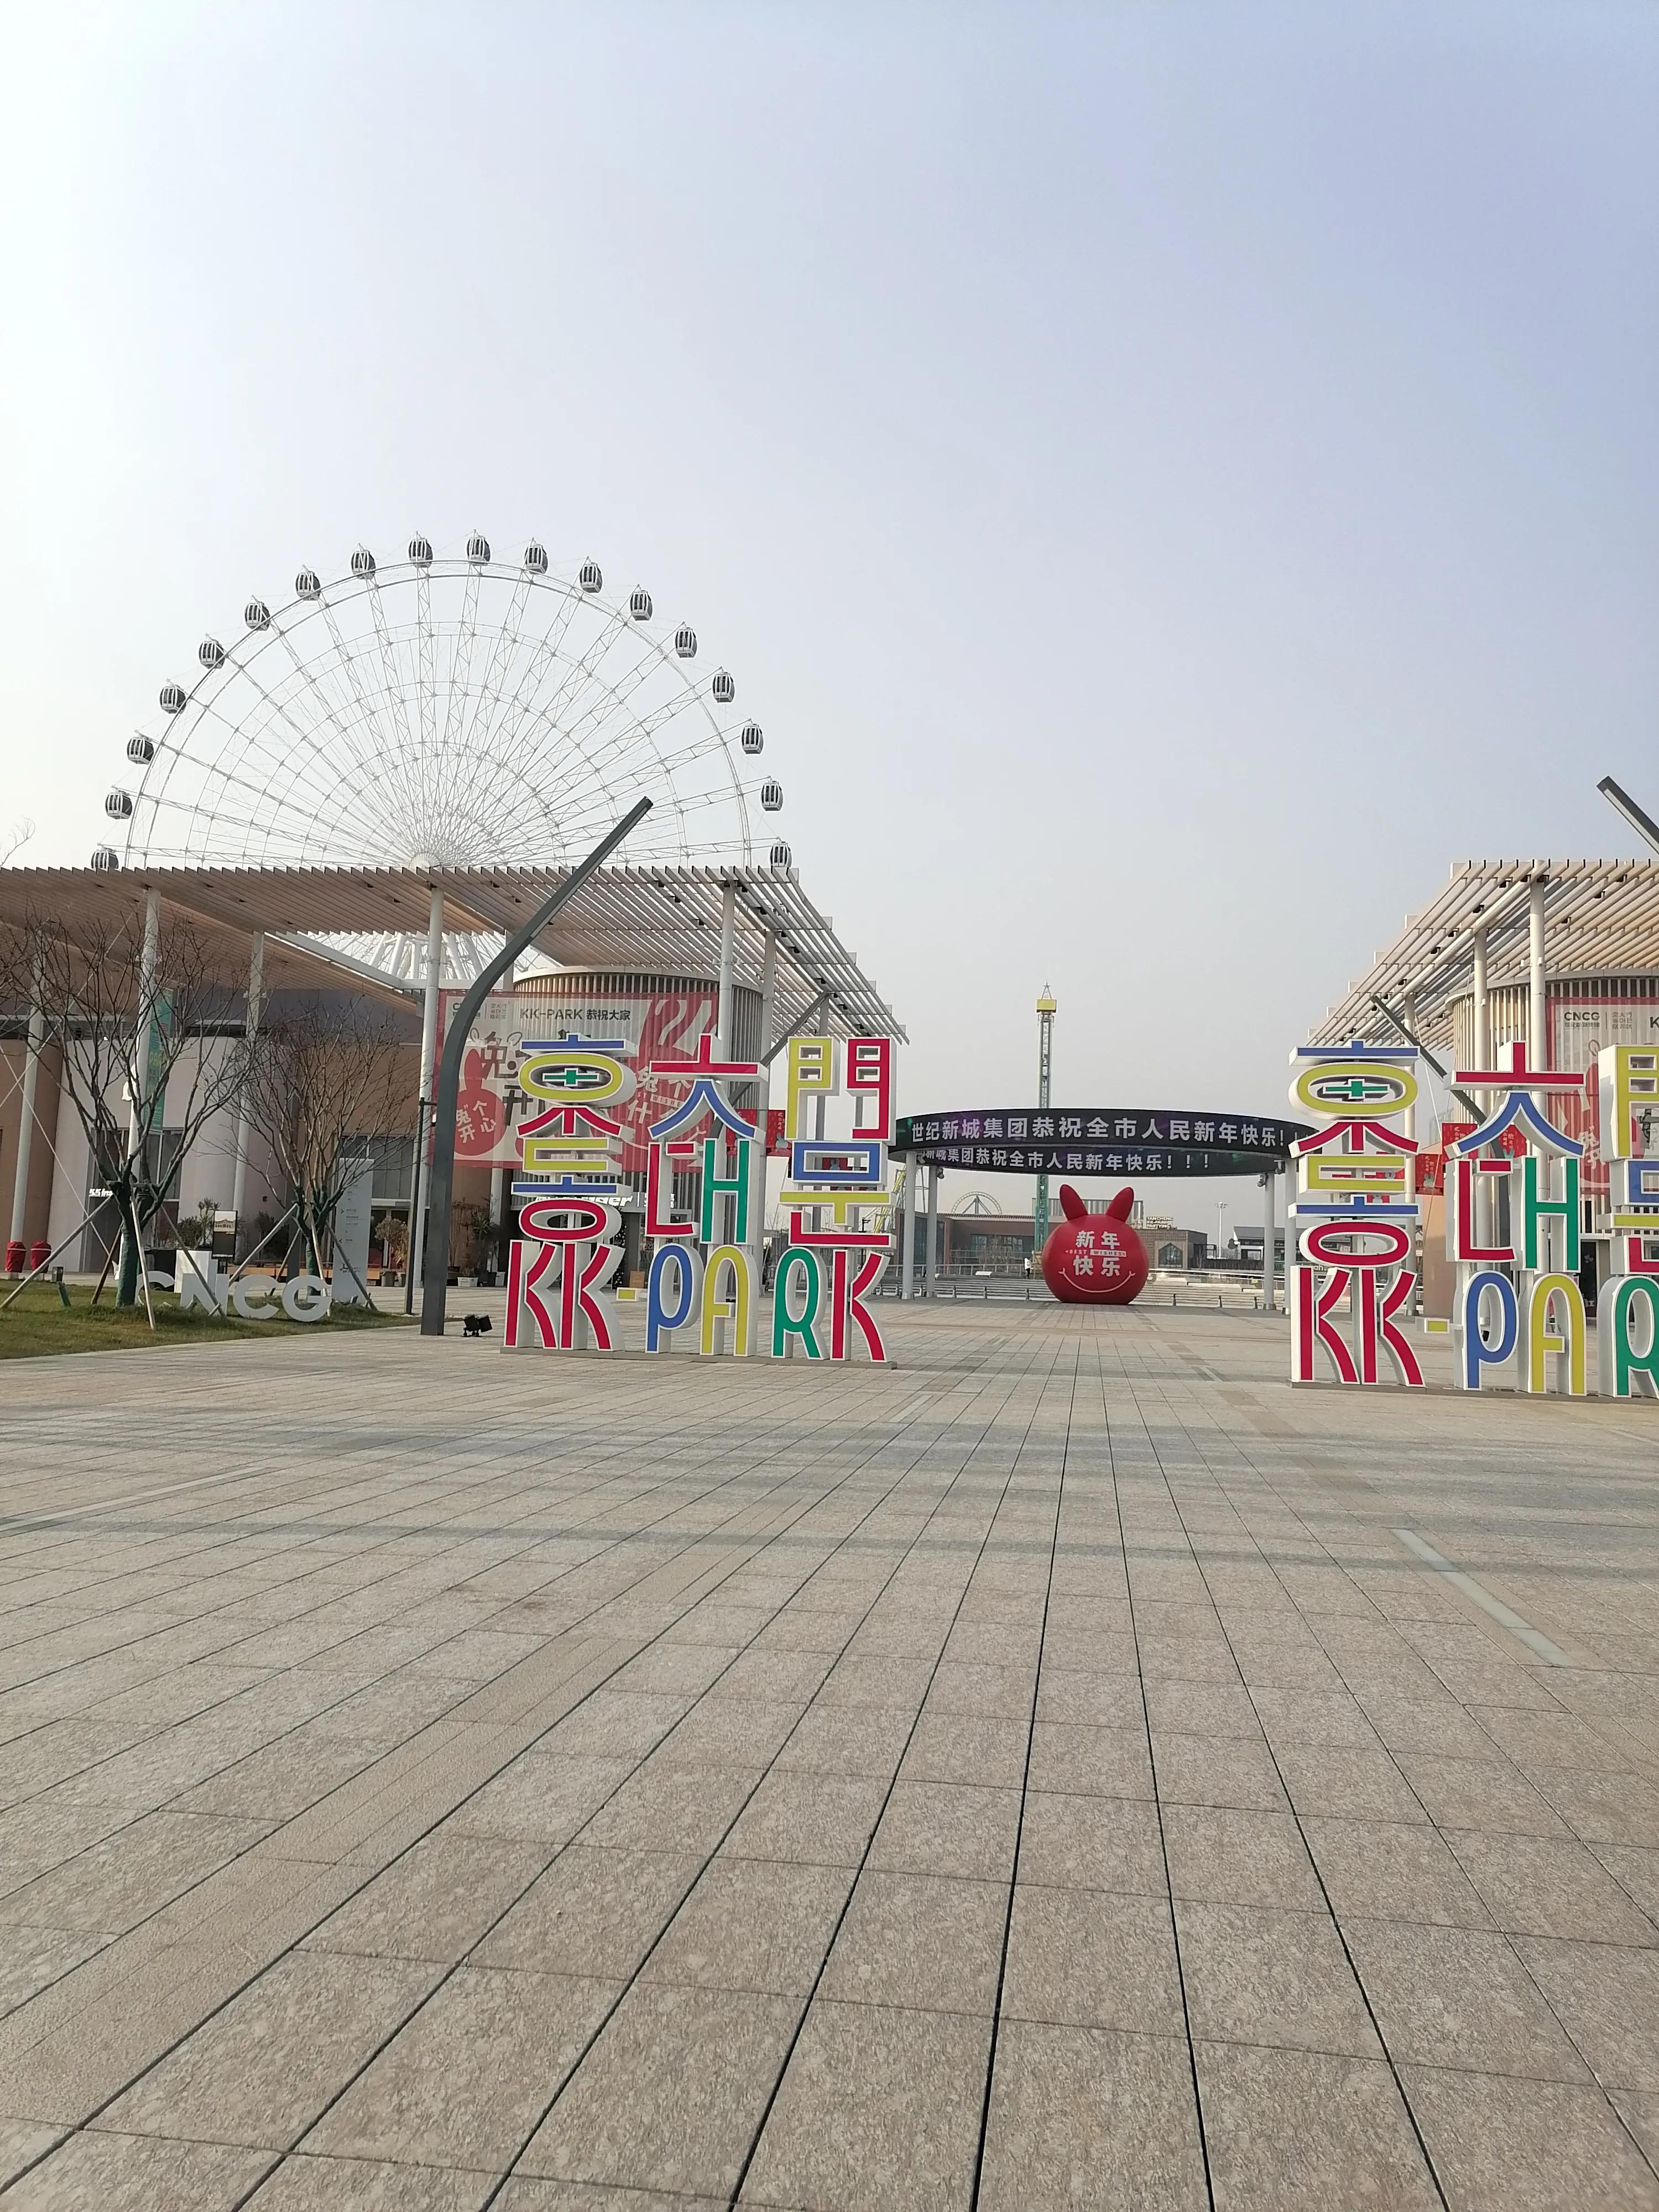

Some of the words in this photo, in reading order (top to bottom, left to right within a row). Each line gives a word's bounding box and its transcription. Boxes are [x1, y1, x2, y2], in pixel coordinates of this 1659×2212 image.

[520, 1009, 583, 1020] KK-PARK
[586, 1009, 631, 1021] 恭祝大家
[1564, 1011, 1599, 1021] CNCG
[1076, 1230, 1120, 1249] 新年
[1073, 1255, 1120, 1277] 快乐
[503, 1239, 889, 1363] KK-PARK
